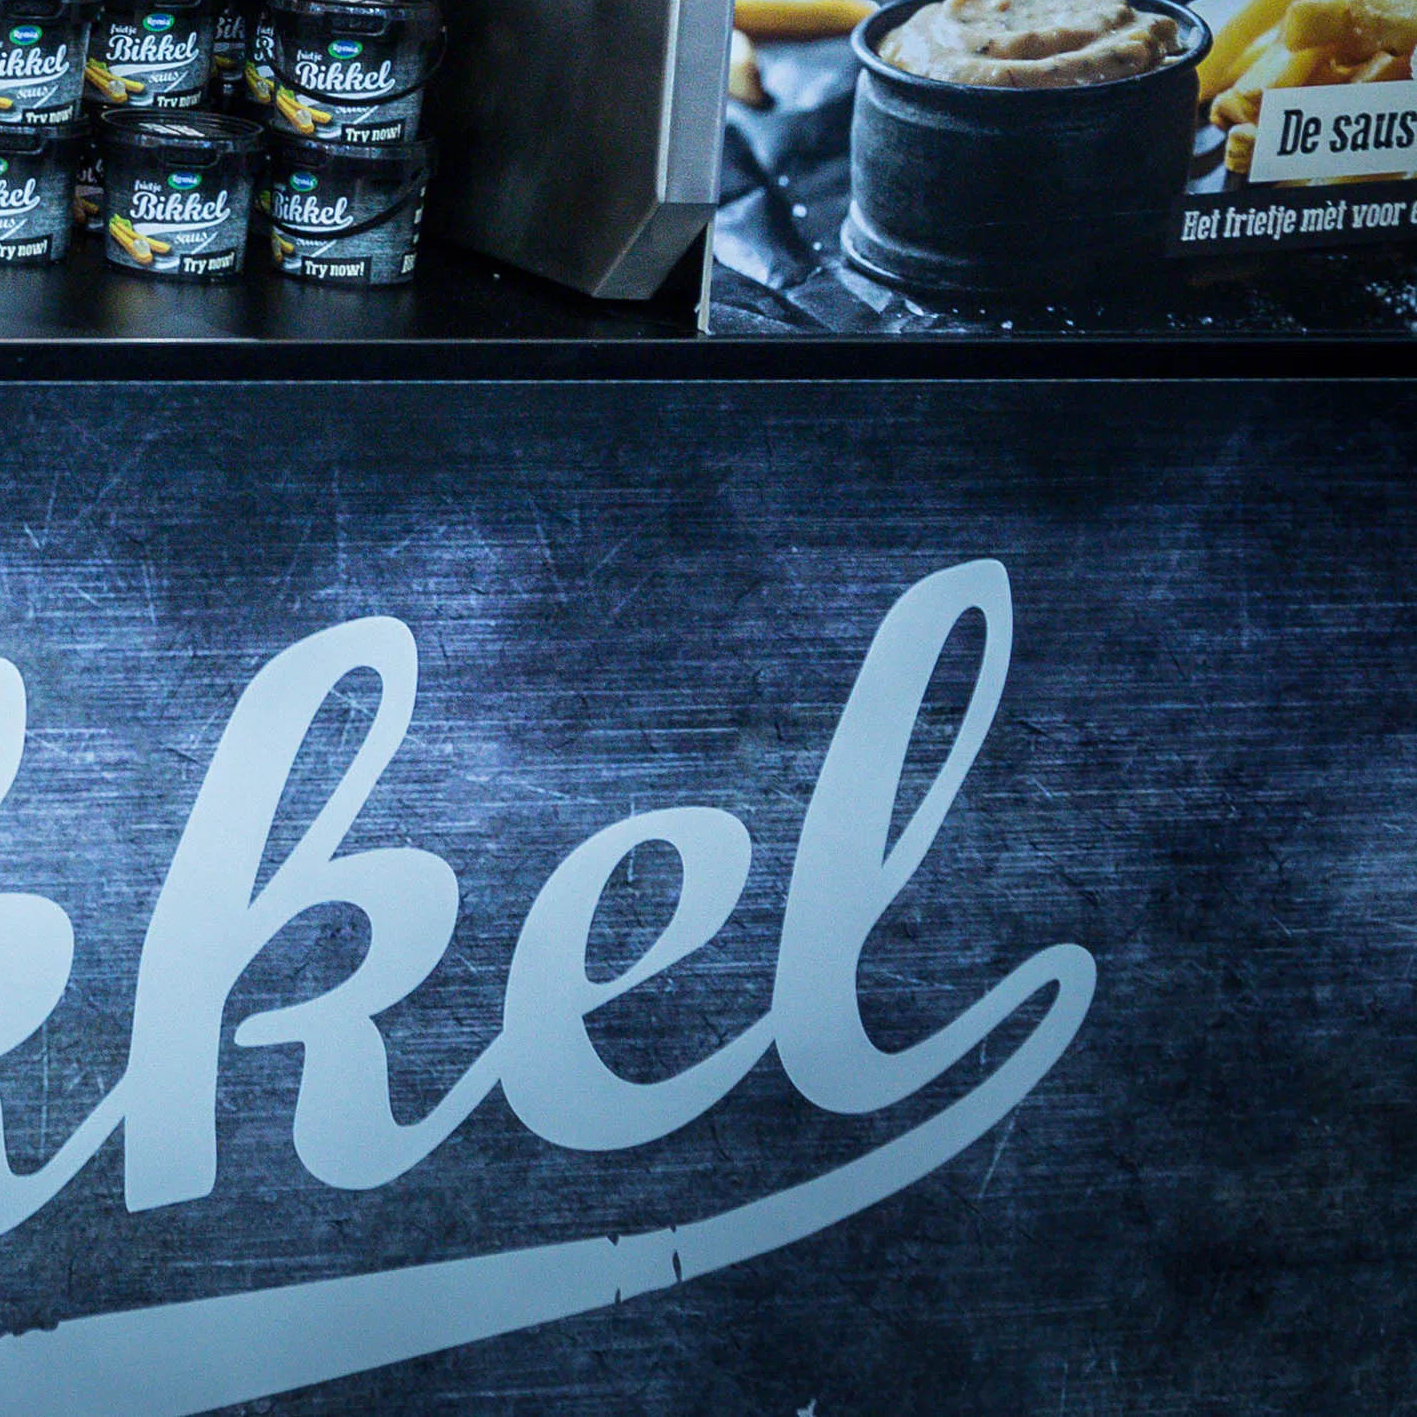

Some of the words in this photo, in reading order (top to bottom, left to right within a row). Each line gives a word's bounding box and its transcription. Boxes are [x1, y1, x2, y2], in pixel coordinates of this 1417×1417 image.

[106, 32, 199, 62] Bikkel
[295, 60, 395, 91] Bikkel
[345, 127, 369, 143] Try
[371, 123, 402, 142] now!
[1277, 109, 1322, 157] De
[1329, 110, 1417, 155] saus
[130, 189, 231, 223] Bikkel
[274, 192, 354, 225] Bikkel
[1180, 208, 1221, 242] Het
[1222, 204, 1297, 241] frietje
[1300, 199, 1347, 233] mèt
[1352, 200, 1407, 229] voor
[183, 256, 208, 275] Try
[305, 260, 328, 279] Try
[330, 262, 365, 277] now!
